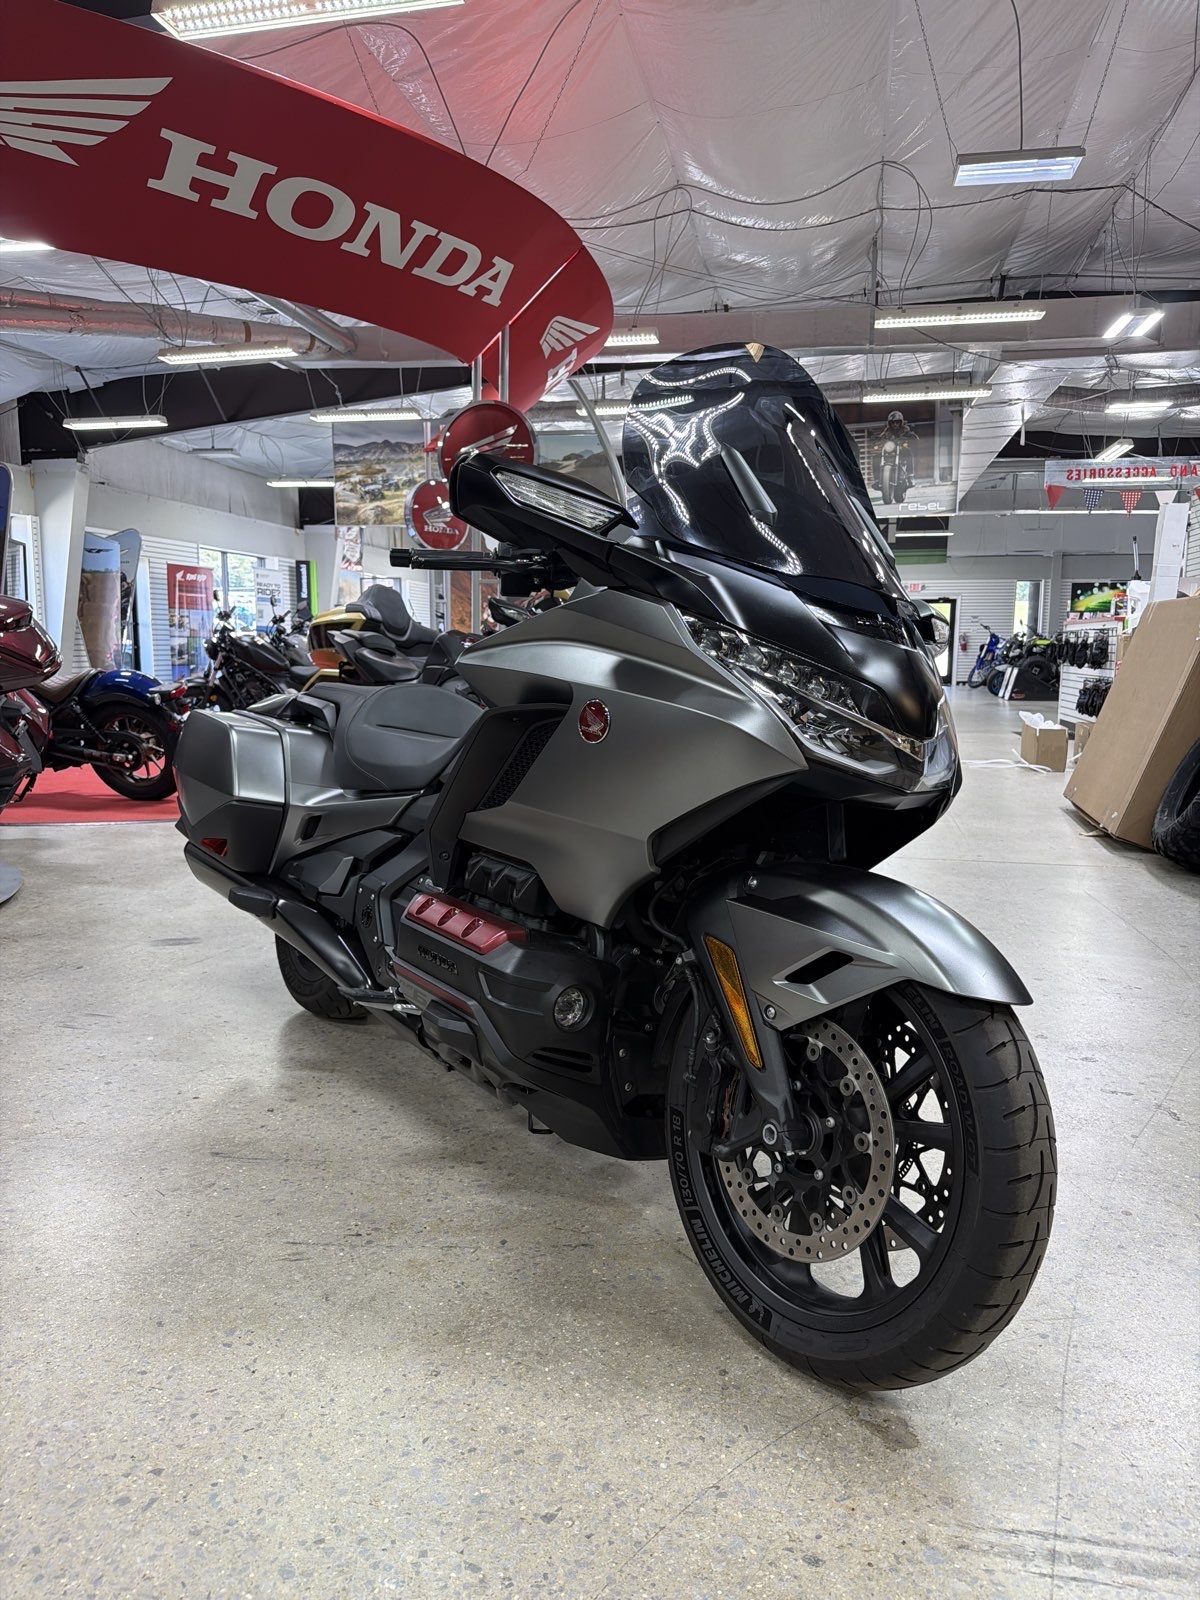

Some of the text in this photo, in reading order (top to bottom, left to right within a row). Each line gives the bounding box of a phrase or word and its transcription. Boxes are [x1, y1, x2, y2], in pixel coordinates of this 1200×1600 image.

[147, 127, 515, 307] HONDA
[672, 1115, 695, 1205] 130/70 R 18
[691, 1218, 750, 1305] MICHELIN
